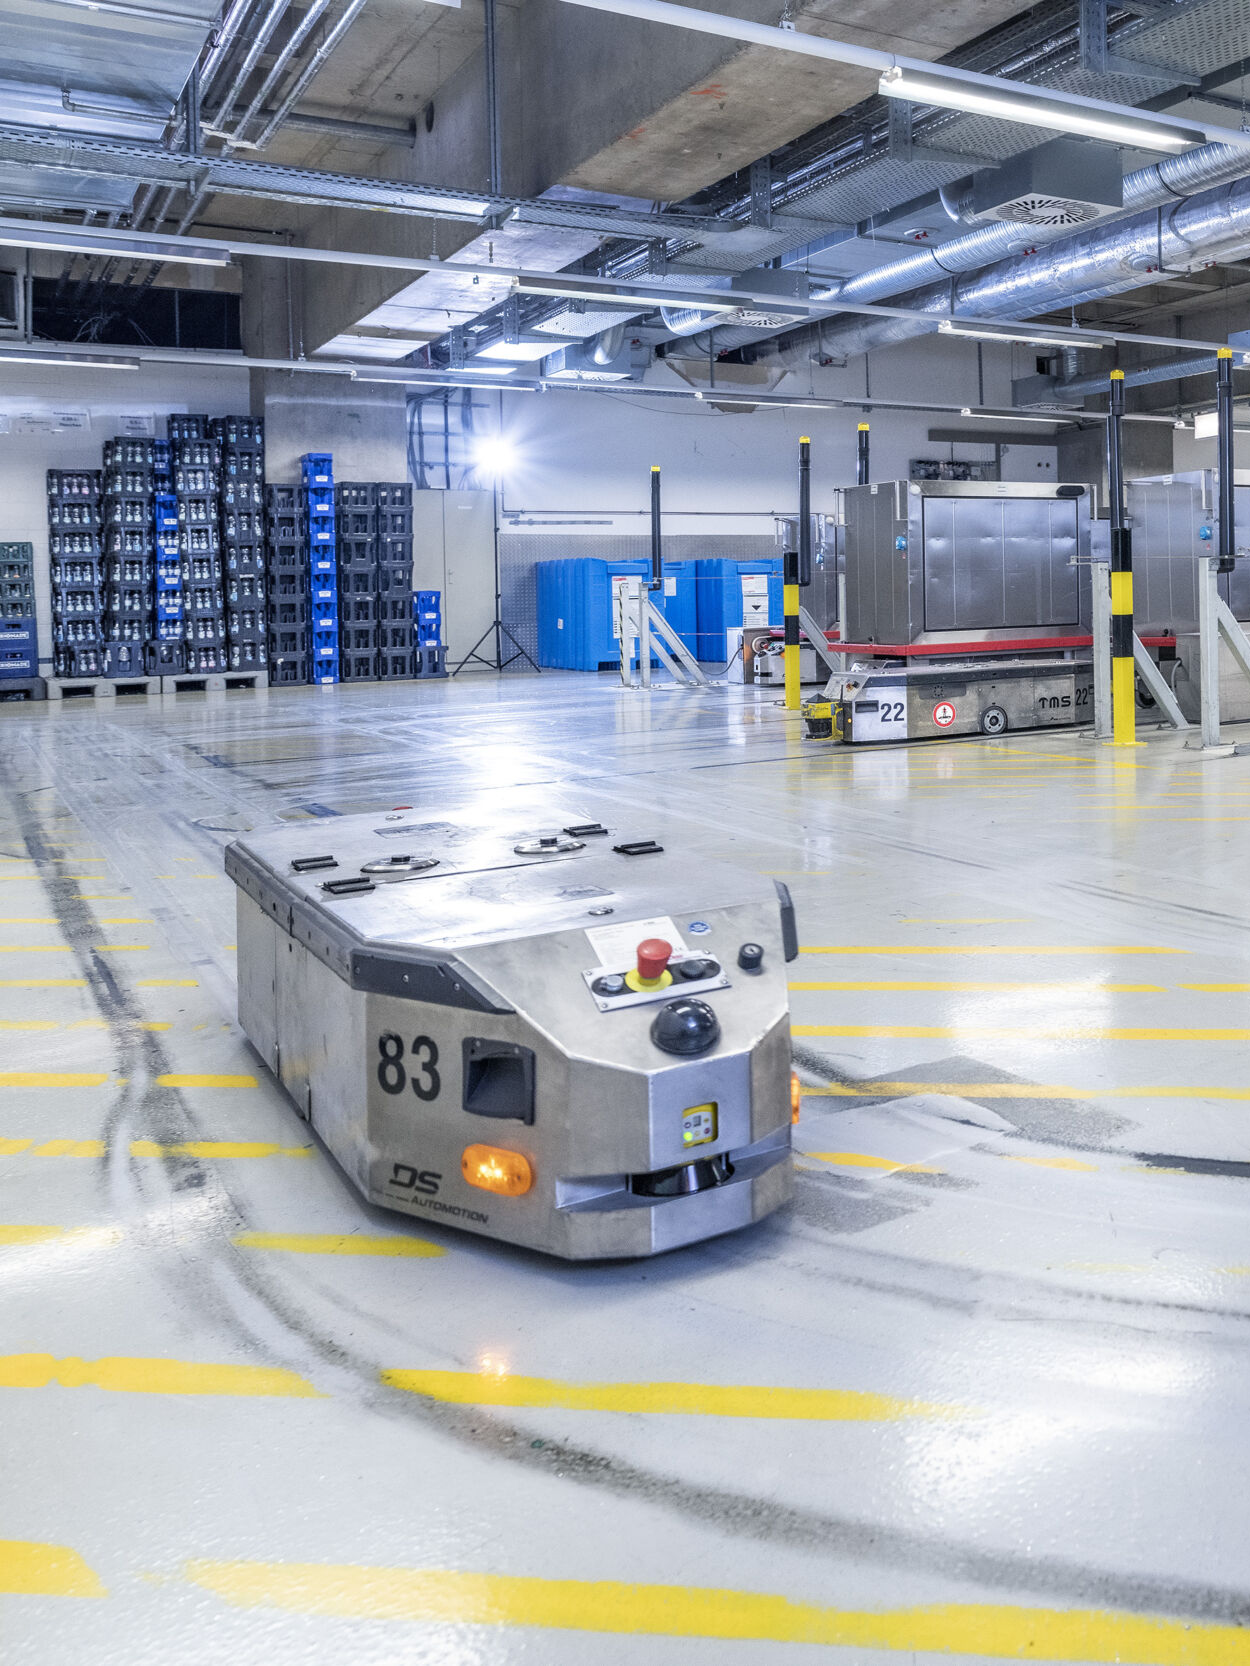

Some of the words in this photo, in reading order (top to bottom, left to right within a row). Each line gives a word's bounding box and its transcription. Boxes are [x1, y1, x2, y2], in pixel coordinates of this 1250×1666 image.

[880, 702, 905, 723] 22
[1038, 695, 1071, 709] TMS
[1075, 688, 1088, 706] 22
[378, 1030, 441, 1102] 83
[389, 1163, 442, 1195] DS
[411, 1195, 489, 1224] AUTOMOTION
